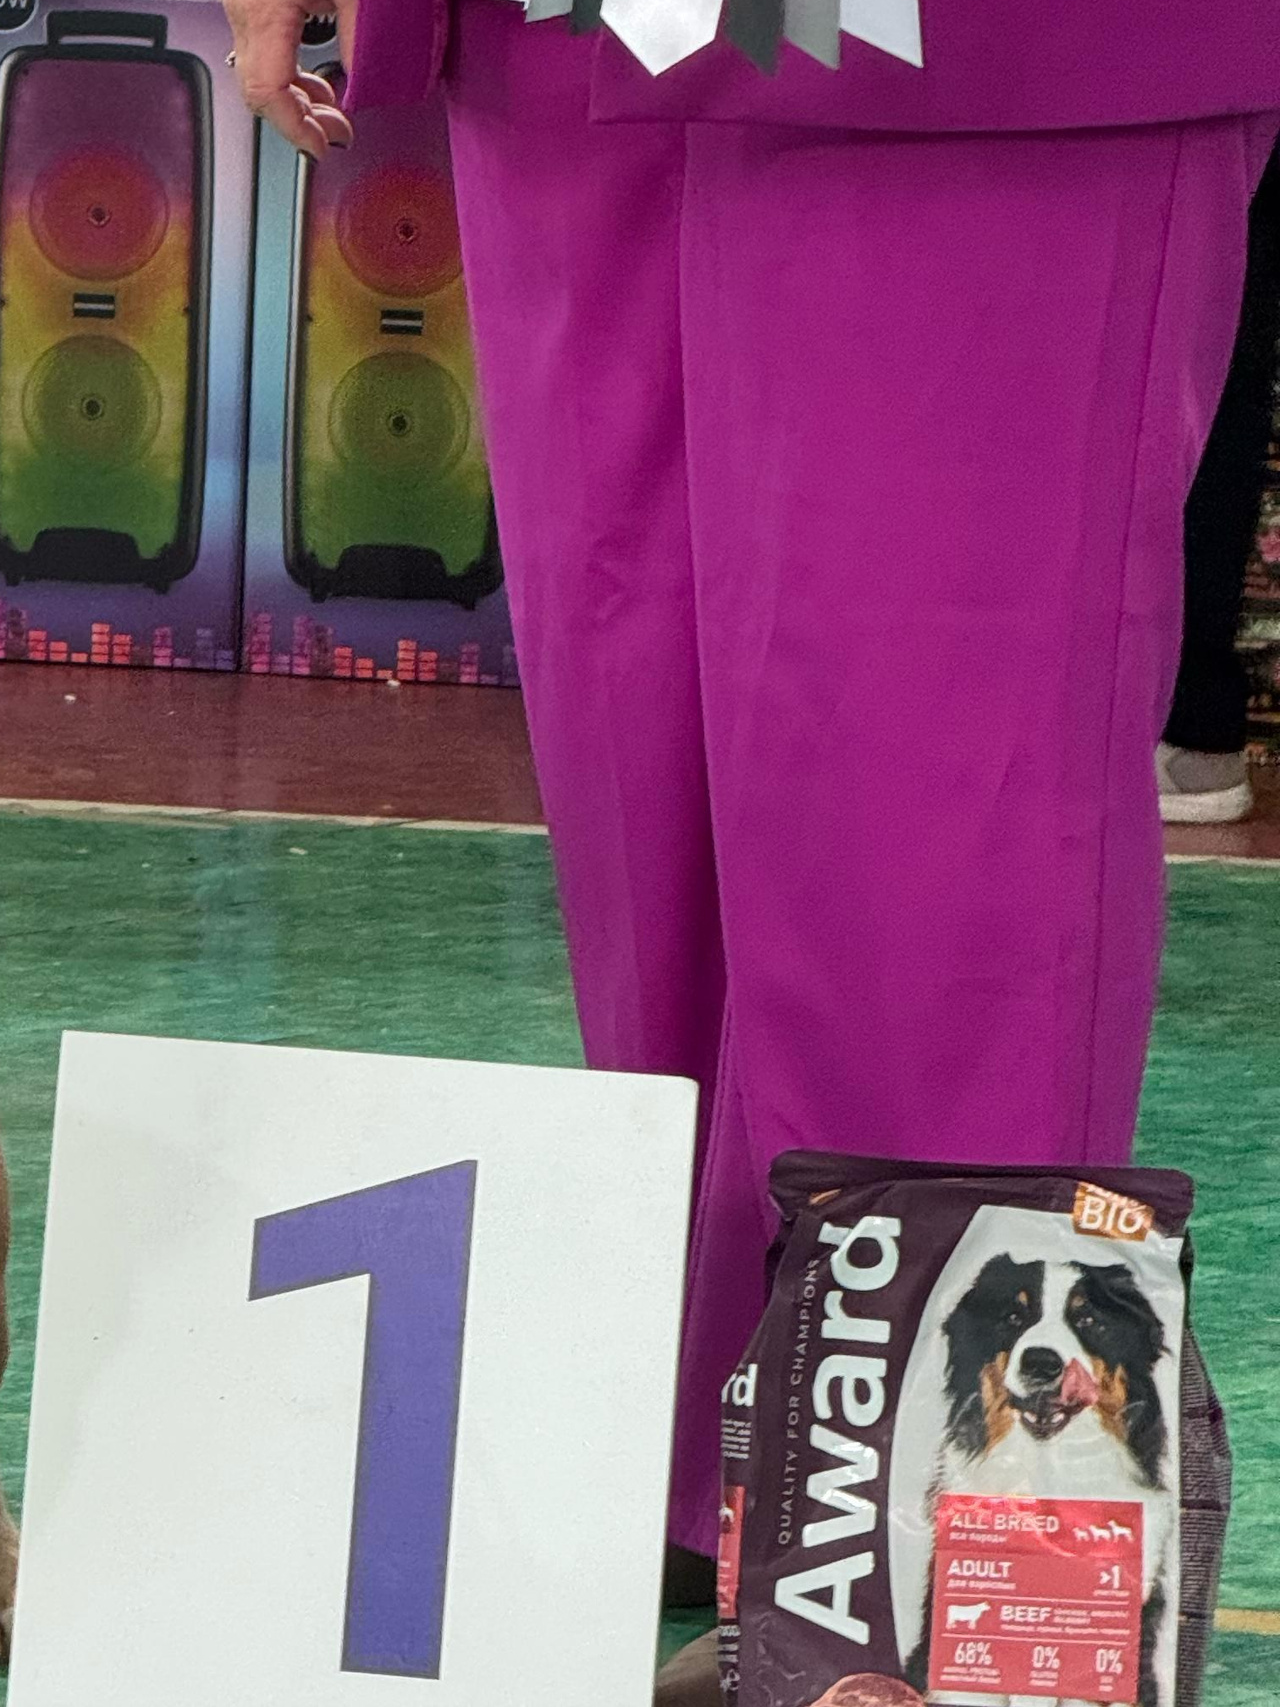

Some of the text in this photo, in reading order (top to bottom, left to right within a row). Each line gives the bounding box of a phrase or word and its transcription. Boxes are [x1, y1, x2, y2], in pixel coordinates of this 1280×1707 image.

[1080, 1195, 1145, 1234] BIO
[777, 1258, 821, 1544] QUALITY FOR CHAMPIONS
[248, 1159, 478, 1681] 1
[775, 1214, 901, 1645] Award
[949, 1512, 1060, 1532] ALL BREED
[947, 1559, 1013, 1578] ADULT
[1000, 1605, 1052, 1622] BEEF
[1032, 1645, 1060, 1669] 0%
[1095, 1648, 1123, 1673] 0%
